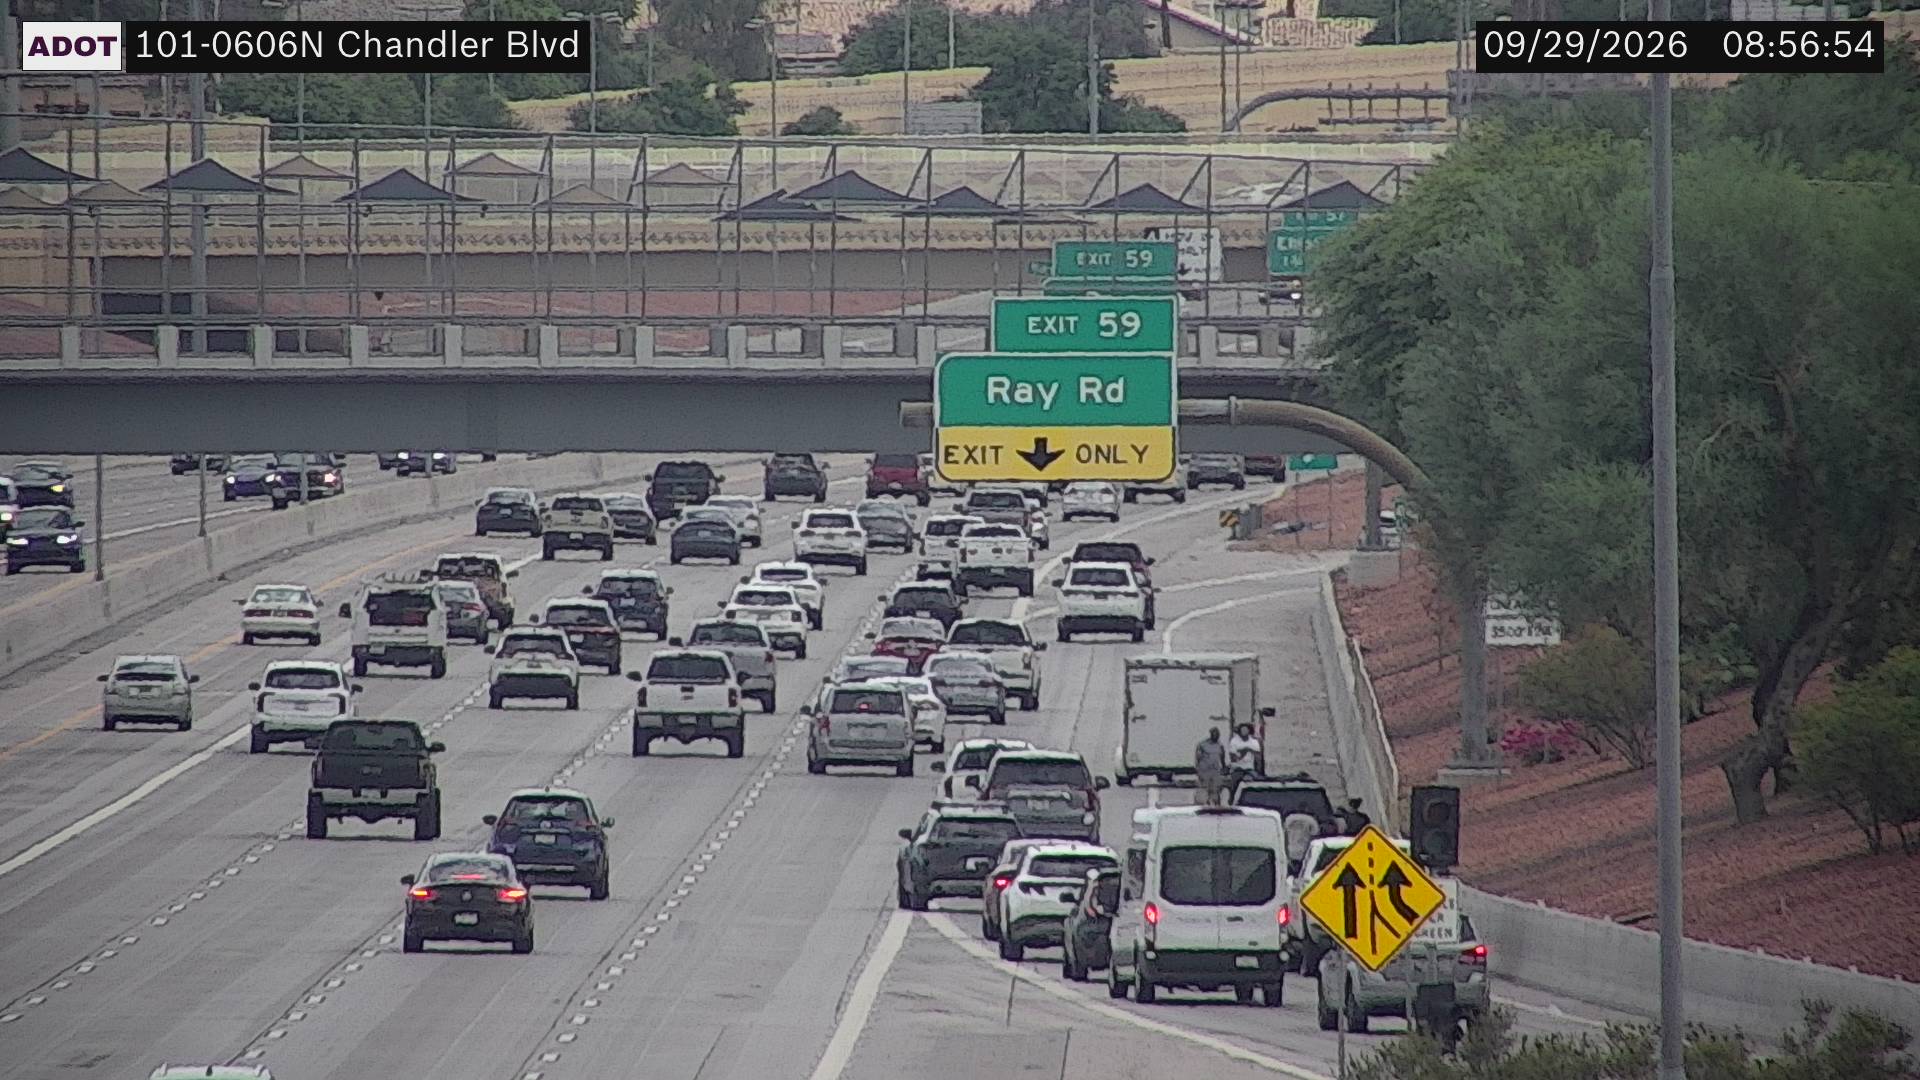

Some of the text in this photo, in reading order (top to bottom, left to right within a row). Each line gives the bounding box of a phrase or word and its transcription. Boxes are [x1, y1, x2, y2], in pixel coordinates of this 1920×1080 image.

[1076, 249, 1154, 268] EXIT 59
[1027, 311, 1141, 338] EXIT 59
[986, 375, 1125, 411] Ray Rd
[943, 443, 1150, 466] EXIT ONLY
